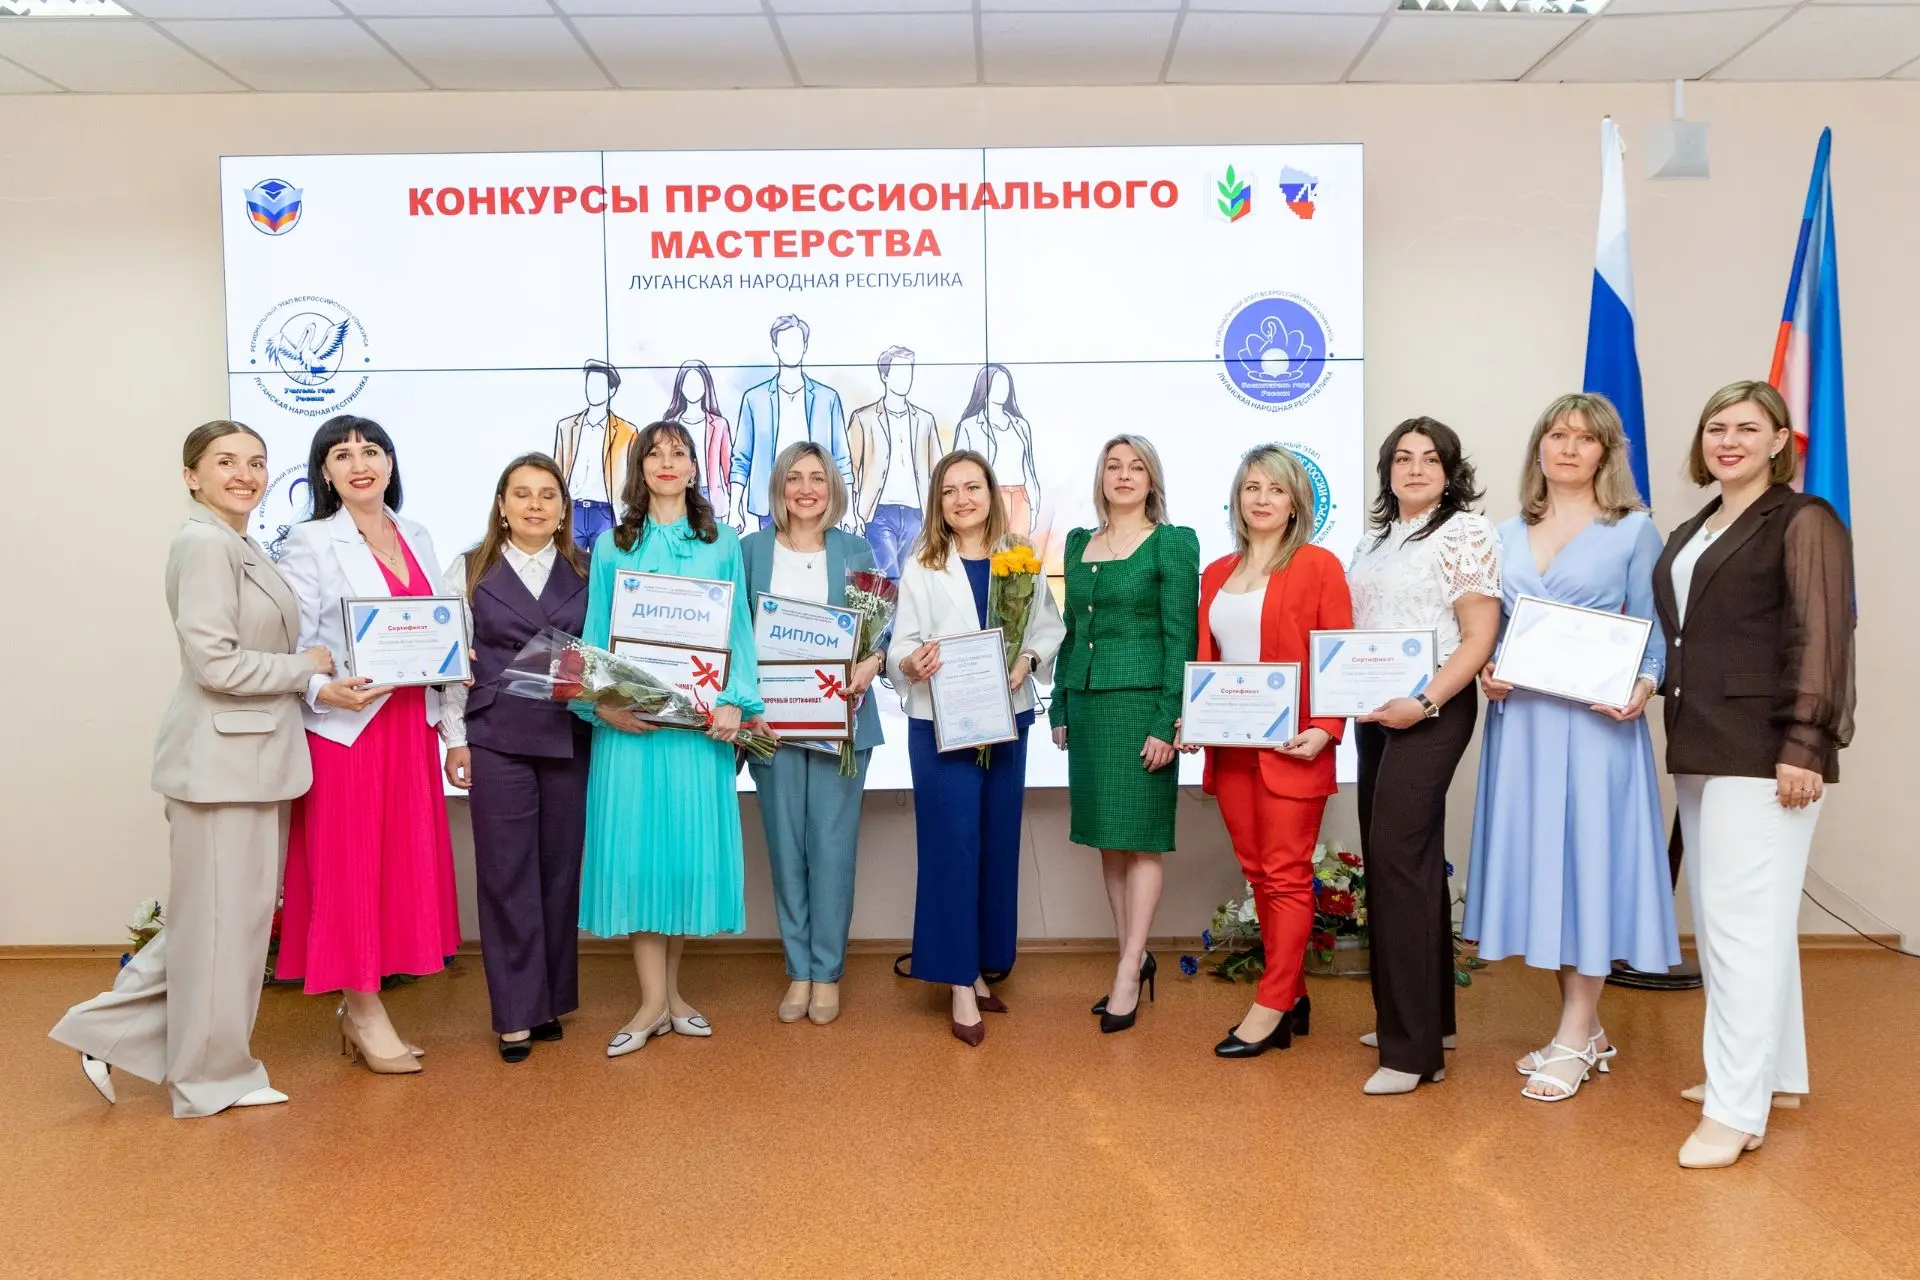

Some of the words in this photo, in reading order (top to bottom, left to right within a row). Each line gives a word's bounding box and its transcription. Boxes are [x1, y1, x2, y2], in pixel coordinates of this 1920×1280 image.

[408, 185, 649, 216] КОНКУРСЫ
[665, 180, 1179, 213] ПРОФЕССИОНАЛЬНОГО
[650, 228, 942, 259] МАСТЕРСТВА
[629, 274, 733, 290] ЛУГАНСКАЯ
[739, 273, 840, 291] НАРОДНАЯ
[845, 272, 963, 289] РЕСПУБЛИКА
[253, 376, 288, 410] ЛУГАНСКАЯ
[288, 406, 331, 417] НАРОДНАЯ
[331, 375, 370, 411] РЕСПУБЛИКА
[1217, 372, 1251, 406] ЛУГАНСКАЯ
[1251, 402, 1293, 412] НАРОДНАЯ
[1294, 371, 1333, 408] РЕСПУБЛИКА
[632, 603, 711, 622] ДИПЛОМ
[769, 624, 839, 648] ДИПЛОМ
